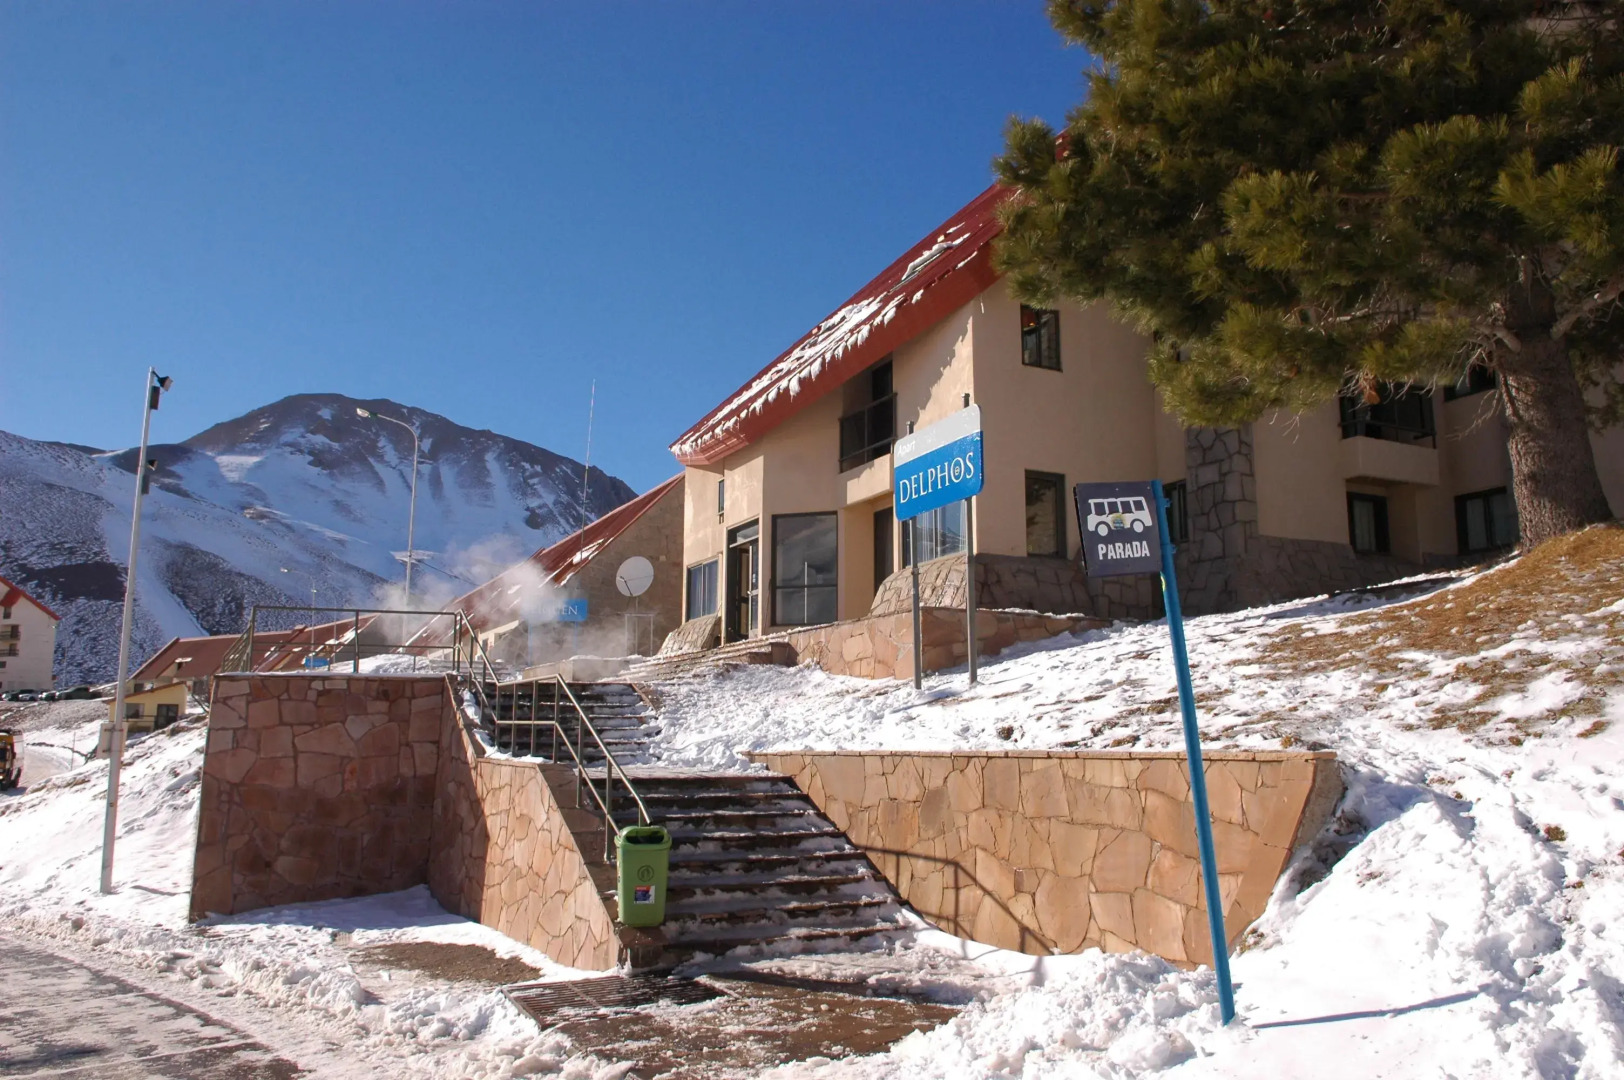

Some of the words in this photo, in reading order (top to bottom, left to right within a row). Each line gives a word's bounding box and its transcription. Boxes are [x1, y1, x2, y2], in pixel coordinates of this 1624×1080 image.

[897, 440, 916, 457] Apart
[899, 451, 974, 504] DELPHOS
[1097, 540, 1151, 560] PARADA
